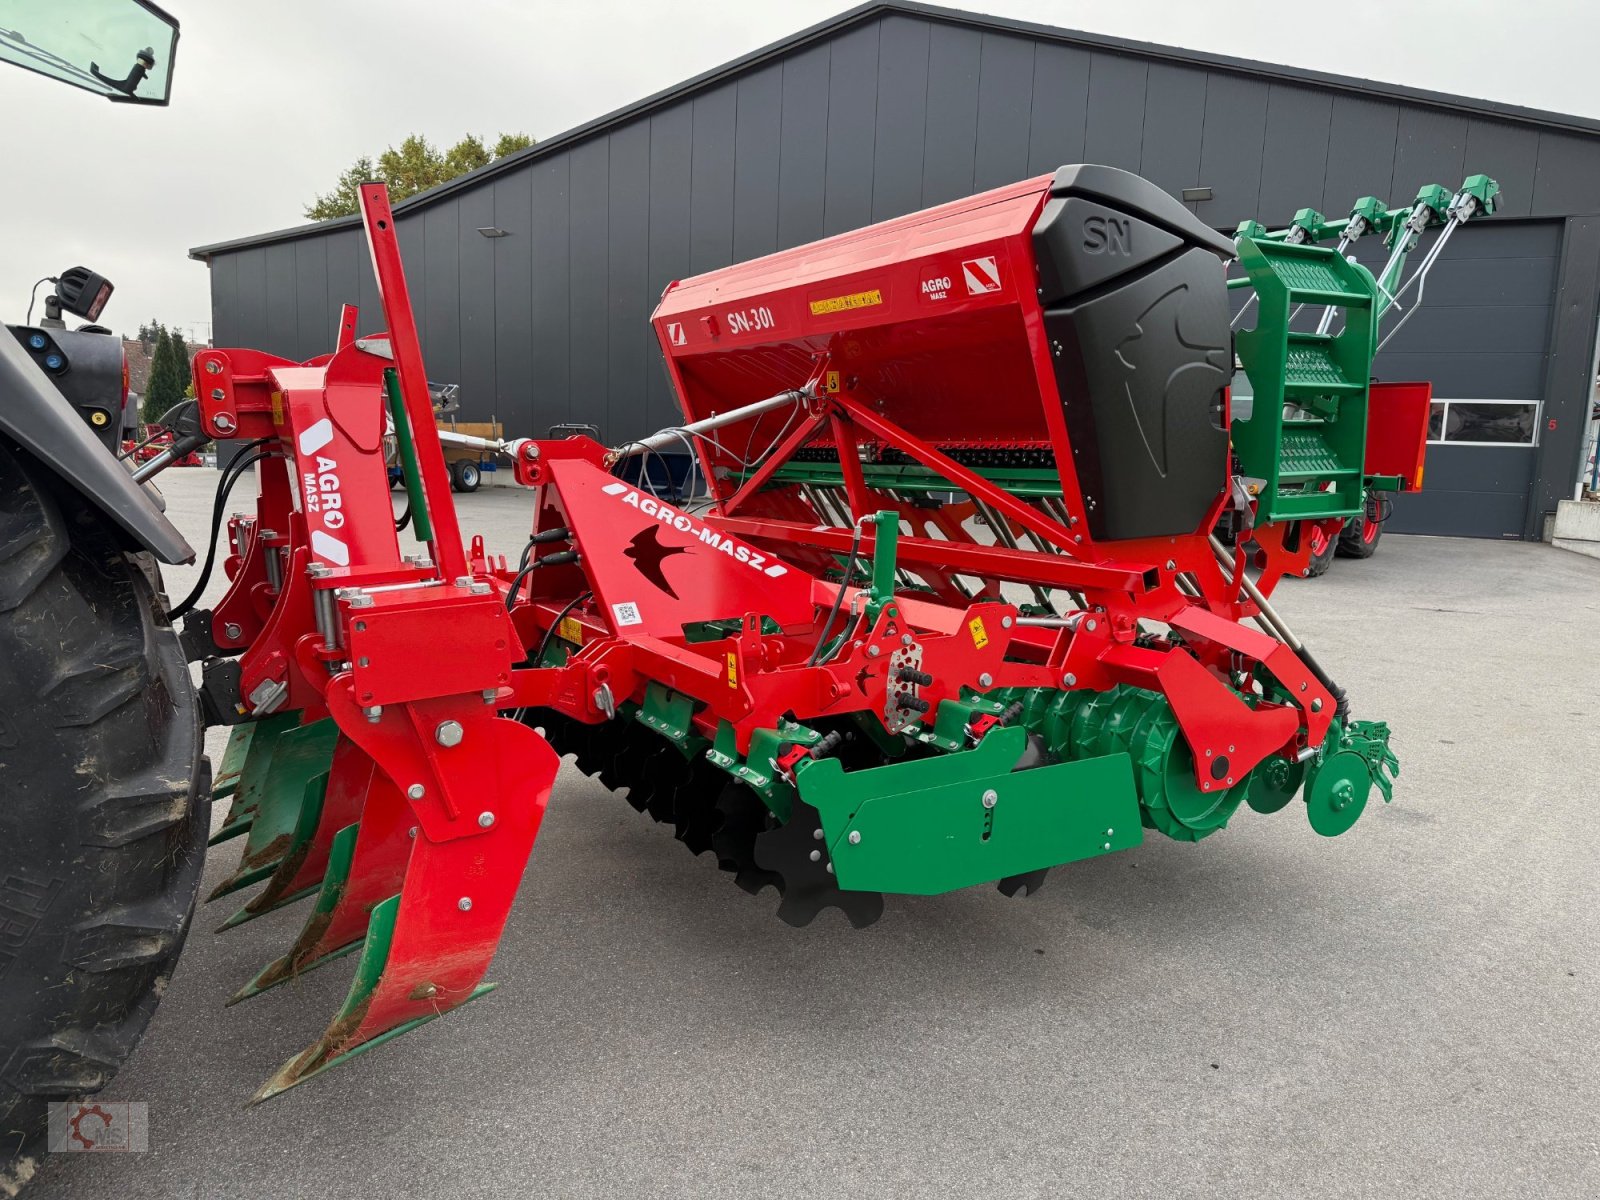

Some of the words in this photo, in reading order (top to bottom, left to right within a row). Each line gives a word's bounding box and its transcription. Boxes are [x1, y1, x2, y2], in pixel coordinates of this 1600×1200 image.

[1082, 215, 1132, 257] SN
[921, 276, 951, 294] AGRO
[930, 291, 947, 301] MASZ
[1548, 419, 1557, 430] 5
[303, 473, 320, 513] MASZ
[316, 456, 345, 529] AGRO
[621, 491, 767, 571] AGRO-MASZ
